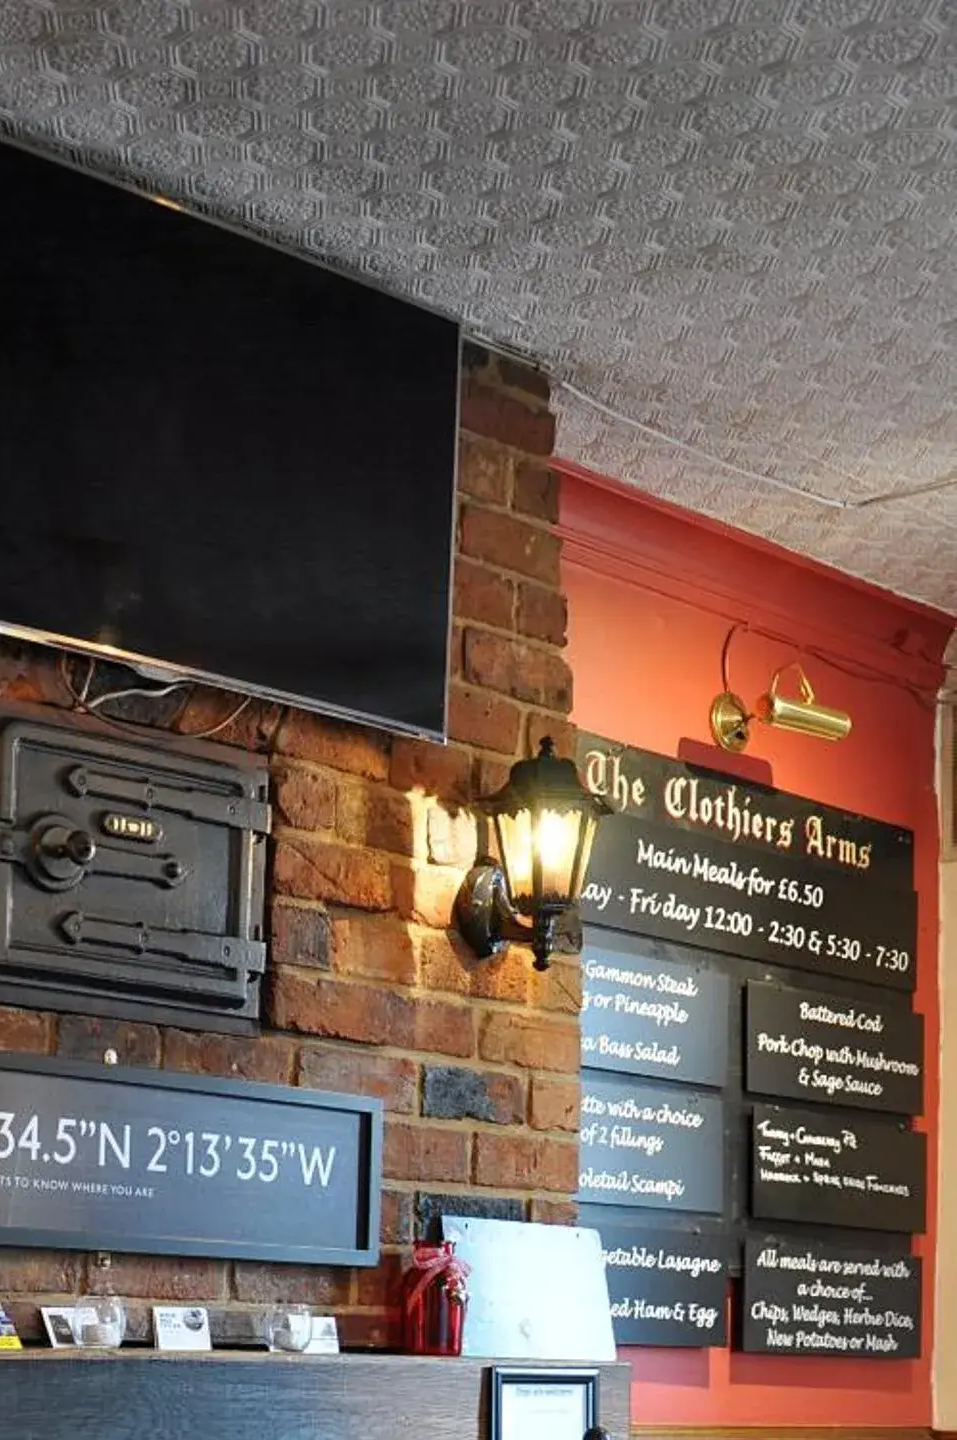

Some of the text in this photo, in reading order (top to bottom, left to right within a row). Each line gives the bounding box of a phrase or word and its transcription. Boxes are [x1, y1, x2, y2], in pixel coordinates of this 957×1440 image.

[585, 750, 872, 870] The Clothiers Arms
[637, 838, 824, 908] Main Meals for £6.50
[704, 905, 753, 936] 12:00
[768, 920, 805, 949] 2:30
[808, 930, 823, 955] &
[826, 934, 861, 961] 5:30
[875, 945, 909, 972] 7:30
[585, 960, 699, 997] Gammon Steak
[594, 995, 613, 1010] or
[614, 993, 690, 1028] Pineapple
[799, 1001, 884, 1032] Battered Cod
[633, 1041, 682, 1067] Salad
[757, 1032, 920, 1076] Pork Chop with Mushroom
[798, 1066, 883, 1096] & Sage Sauce
[607, 1099, 642, 1119] with
[656, 1103, 704, 1128] choice
[580, 1122, 664, 1156] of 2 fillings
[14, 1176, 30, 1189] TO
[33, 1178, 69, 1191] KNOW
[71, 1181, 110, 1195] WHERE
[111, 1184, 133, 1197] YOU
[134, 1187, 154, 1198] ARE
[630, 1174, 685, 1201] Scampi
[658, 1249, 722, 1278] Lasagne
[756, 1249, 911, 1278] All meals are served with
[809, 1278, 850, 1299] choice
[633, 1299, 673, 1320] Ham
[673, 1302, 686, 1322] &
[688, 1303, 718, 1328] Egg
[766, 1328, 899, 1353] New Potatoes or Mash
